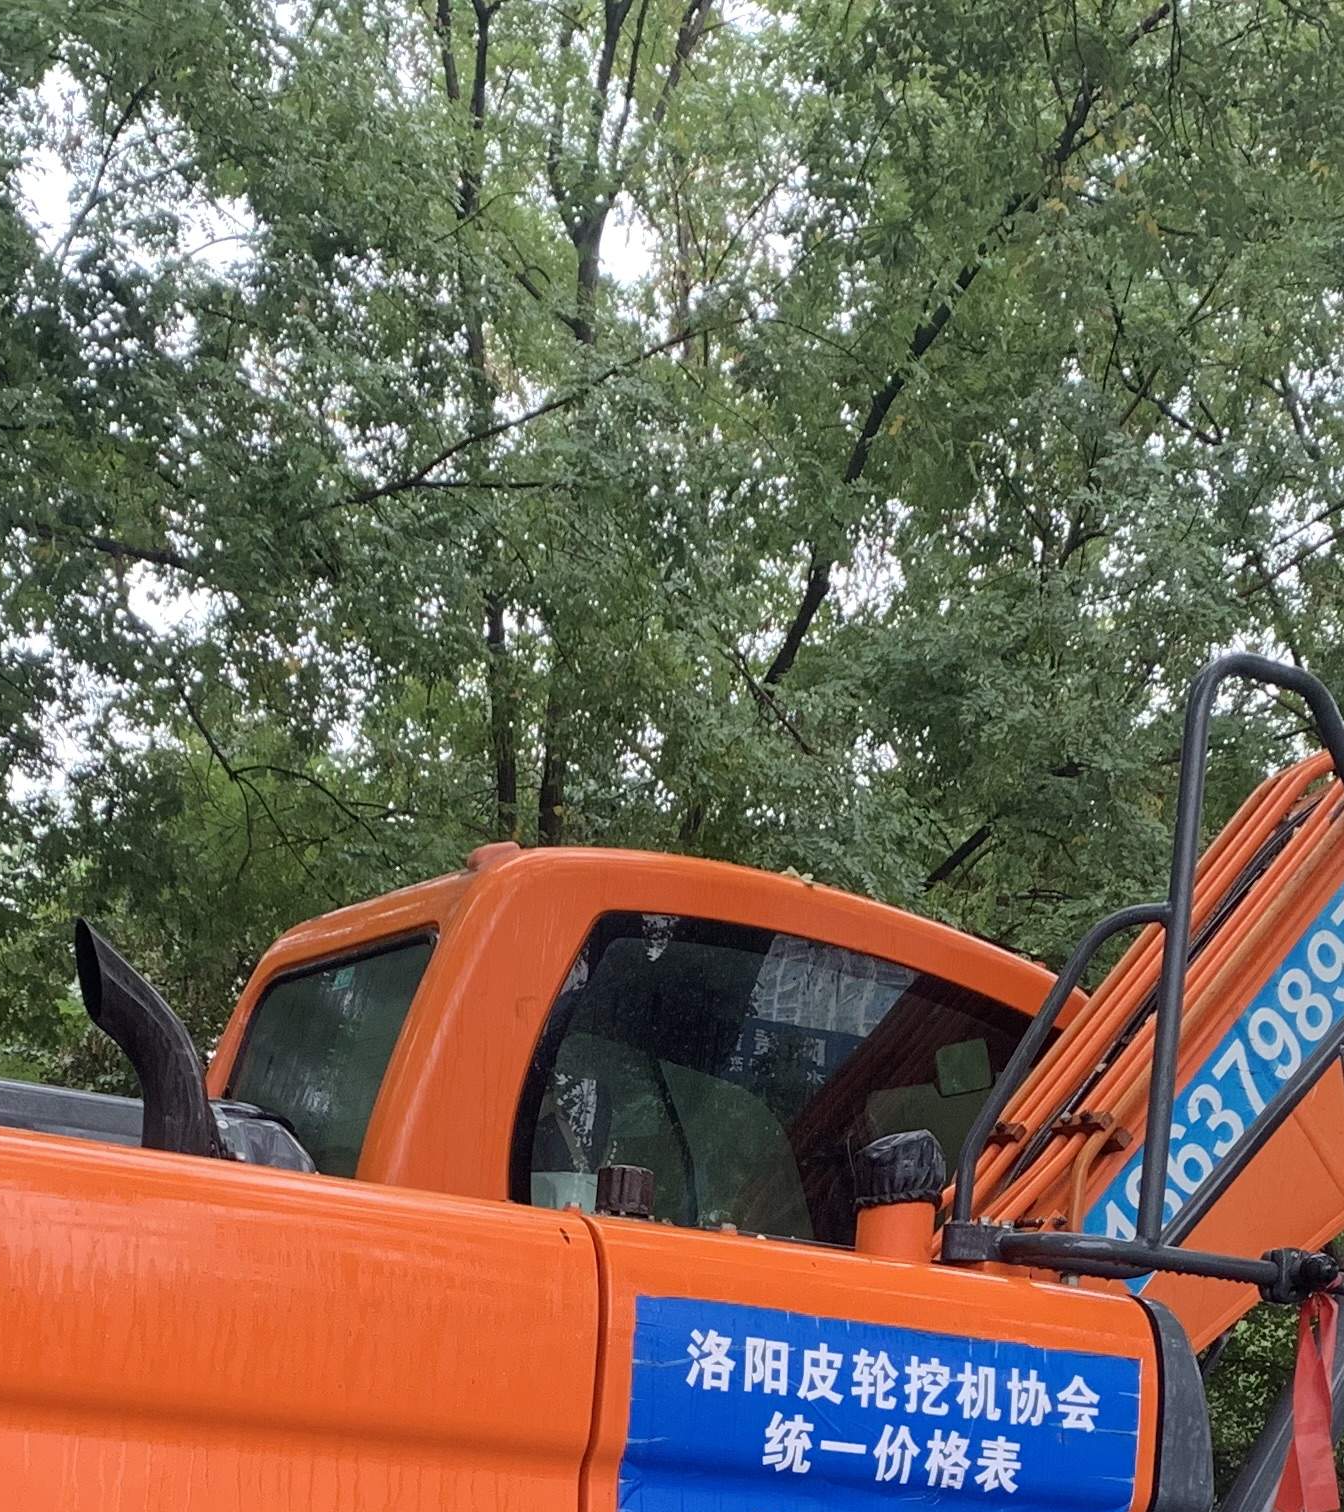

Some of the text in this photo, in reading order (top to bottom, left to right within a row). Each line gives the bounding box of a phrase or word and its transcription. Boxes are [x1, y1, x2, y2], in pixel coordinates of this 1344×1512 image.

[685, 1328, 1101, 1433] 洛阳皮轮挖机协会
[762, 1411, 1022, 1494] 统一价格表
